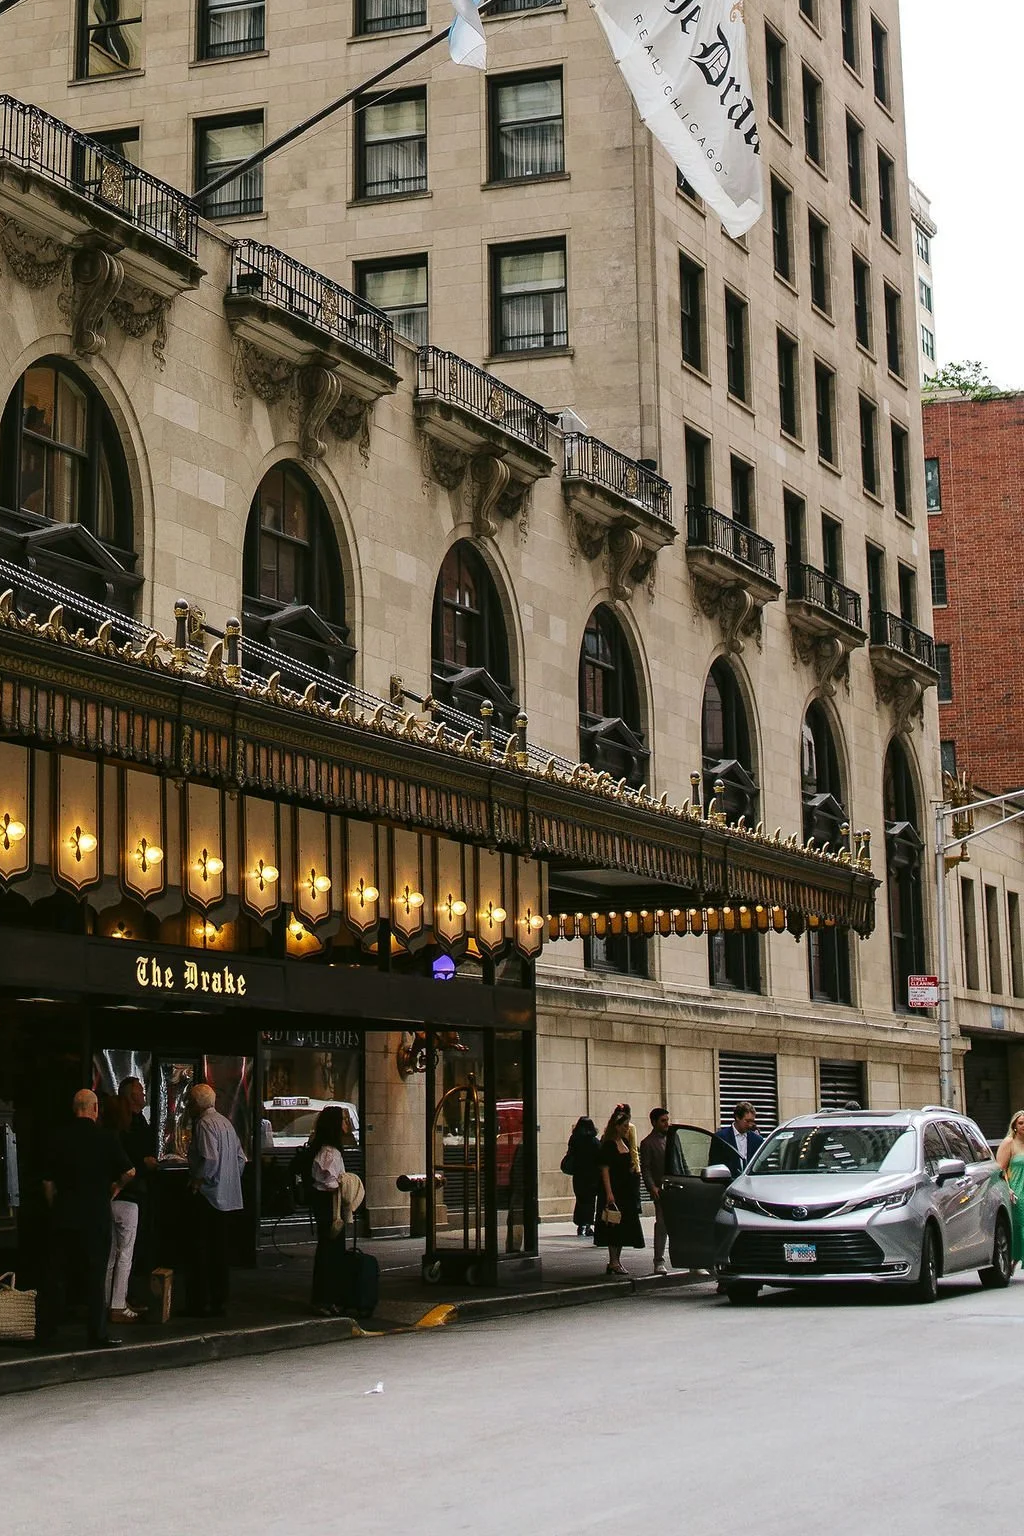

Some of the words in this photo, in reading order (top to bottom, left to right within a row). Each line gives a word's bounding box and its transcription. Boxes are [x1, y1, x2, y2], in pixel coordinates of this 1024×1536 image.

[633, 13, 661, 71] REAL
[688, 22, 761, 156] Drak
[136, 956, 175, 989] The
[183, 960, 247, 996] Drake
